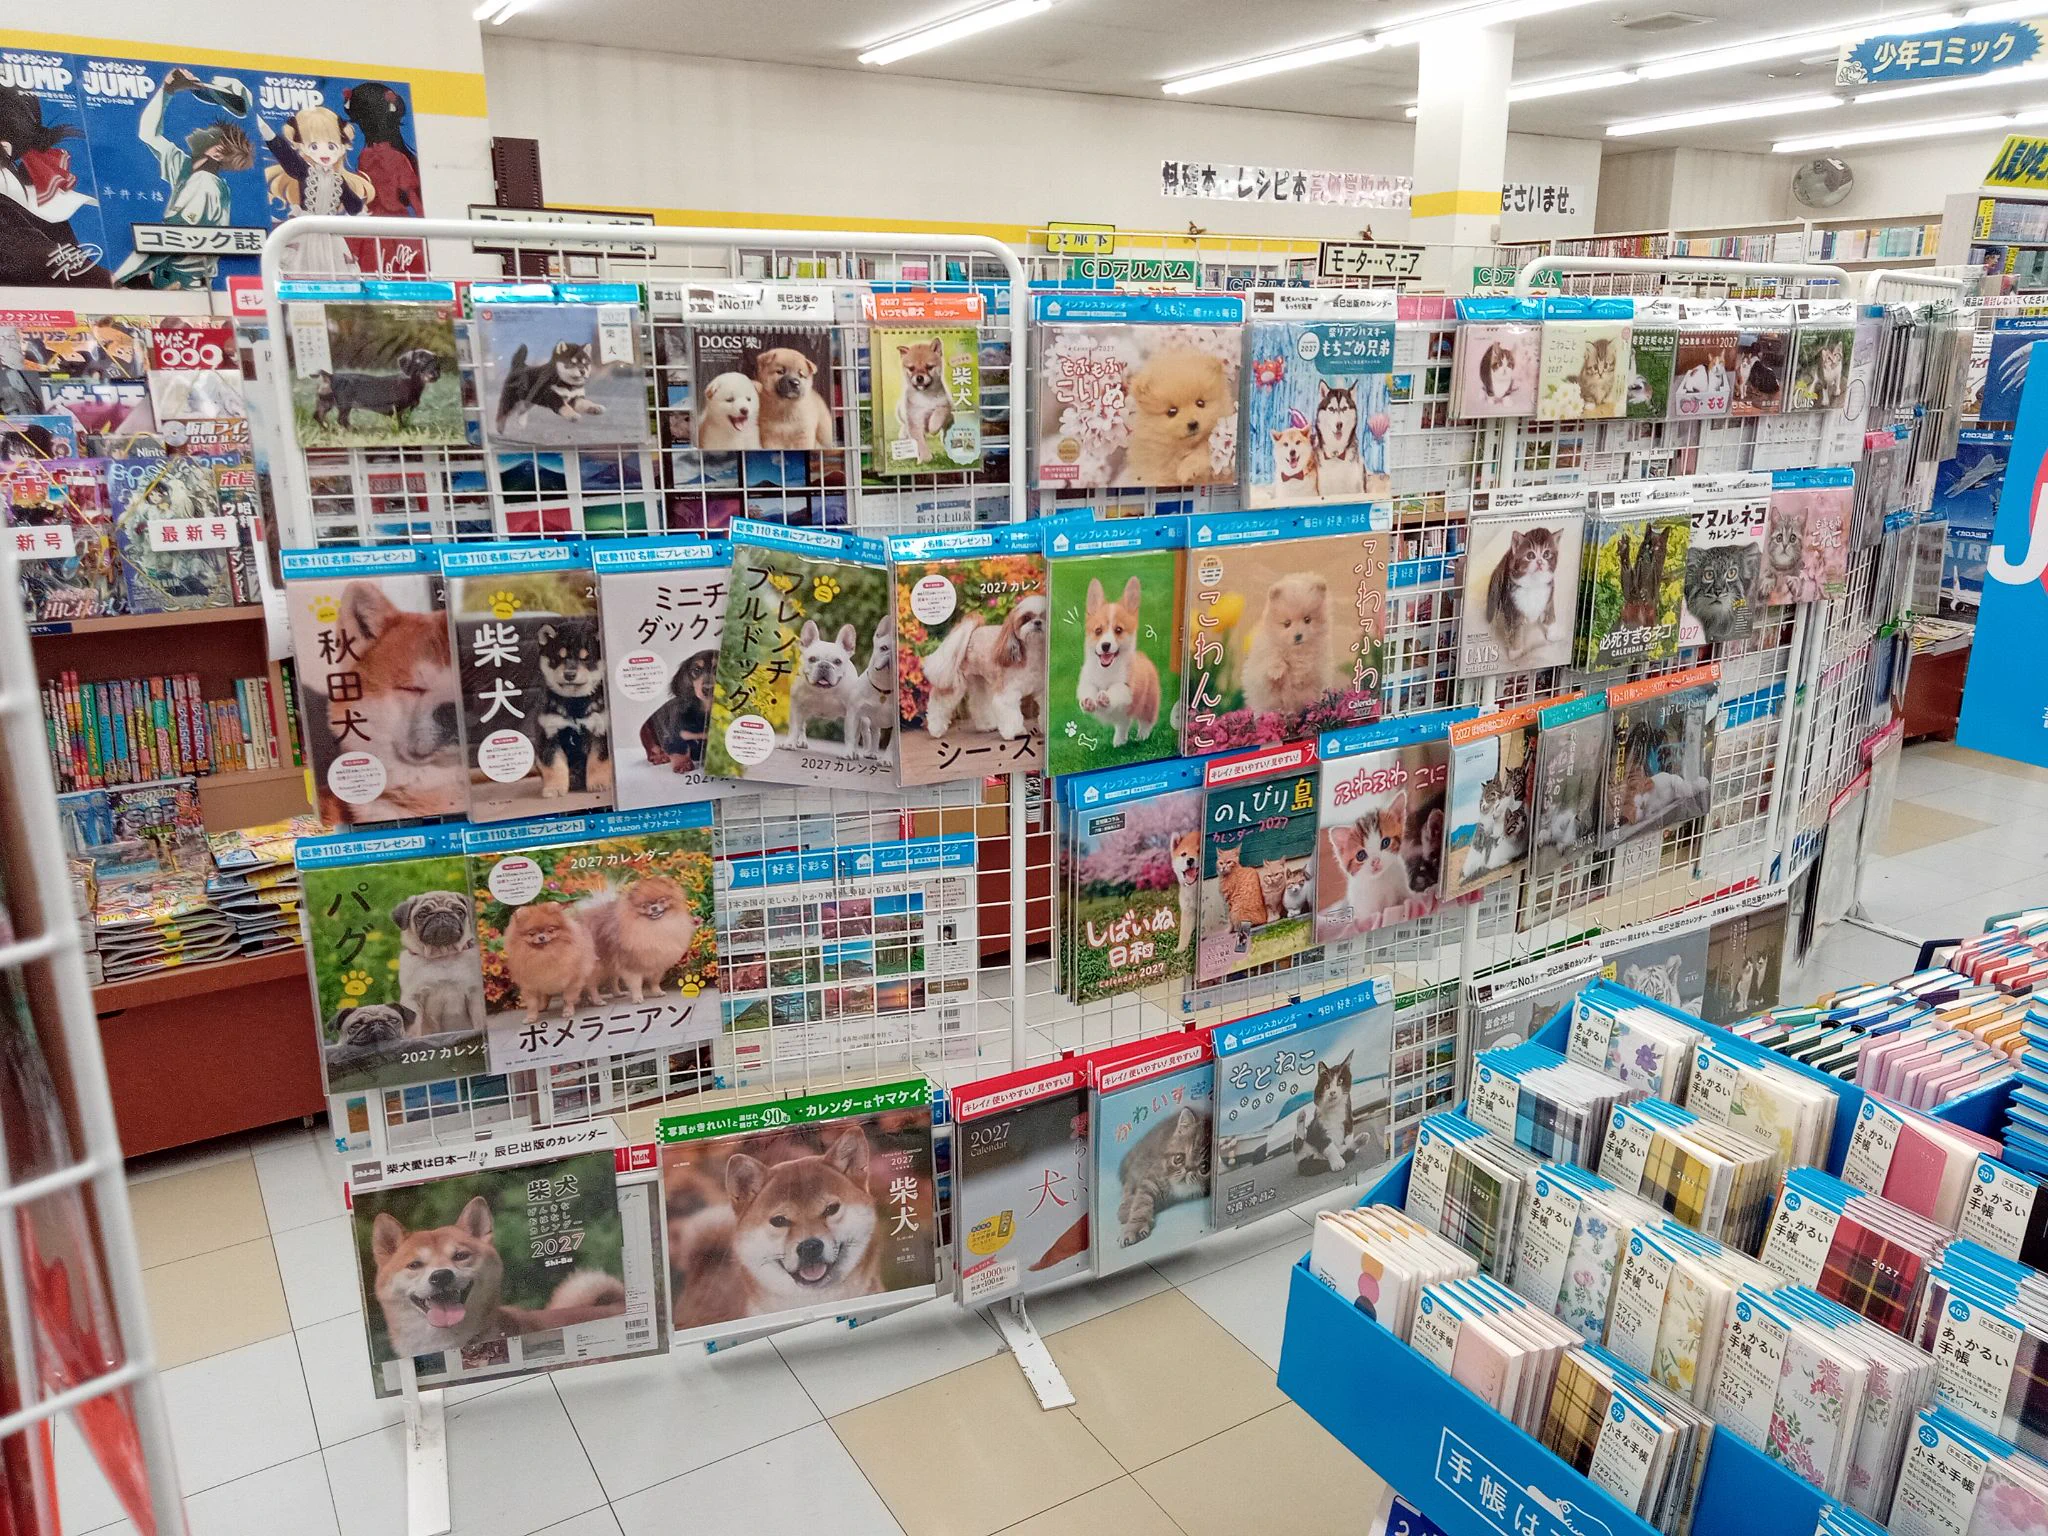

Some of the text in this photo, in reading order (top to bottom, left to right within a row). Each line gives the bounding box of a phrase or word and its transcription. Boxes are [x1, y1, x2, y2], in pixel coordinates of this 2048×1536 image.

[1872, 32, 2015, 73] 少年コミック
[141, 229, 263, 251] コミック誌
[1081, 260, 1190, 280] CDアルバム
[1479, 268, 1557, 284] CDアバム
[780, 303, 816, 311] カレンダー
[154, 331, 204, 349] サイボーグ
[1301, 345, 1317, 353] 2027
[1321, 339, 1391, 358] もちごめ兄弟
[1720, 336, 1738, 348] 2027
[1061, 357, 1121, 378] もふもふ
[952, 367, 973, 407] 柴犬
[1056, 380, 1125, 410] こいぬ
[162, 521, 227, 543] 最新号
[1707, 529, 1745, 541] カレンダー
[656, 581, 728, 611] ミニチ
[980, 581, 1006, 594] 2027
[1350, 539, 1385, 694] ふわふわ
[729, 565, 776, 713] ブルドッグ
[1600, 624, 1672, 651] 必死すぎるネコ
[1466, 643, 1499, 665] CATS
[1611, 646, 1644, 657] CALENDAR
[473, 622, 526, 724] 柴犬
[1191, 591, 1224, 748] こわんこ
[1464, 663, 1500, 674] COLLECTION
[318, 628, 372, 743] 秋田犬
[1348, 698, 1379, 710] Calendar
[801, 757, 891, 775] 2027 カレンダー
[1334, 761, 1408, 808] ふわふわ
[1214, 777, 1314, 824] のんびり島
[608, 824, 641, 833] Amazon
[1212, 815, 1289, 844] カレンダー 2027
[571, 849, 670, 869] 2027 カレンダー
[325, 881, 374, 966] パグ
[1086, 906, 1177, 948] しばいぬ
[1107, 942, 1156, 969] 日和
[1139, 963, 1165, 979] 2027
[519, 1005, 692, 1054] ポメラニアン
[401, 1049, 436, 1065] 2027
[1230, 1049, 1317, 1092] そとねこ
[1692, 1082, 1709, 1099] 手帳
[1694, 1071, 1730, 1096] あ、かるい
[805, 1089, 920, 1118] カレンダーはヤマケイ
[1475, 1095, 1494, 1112] 手帳
[1477, 1085, 1515, 1108] あ、かるい
[494, 1130, 608, 1158] 辰巳出版のカレンダー
[971, 1122, 1010, 1149] 2027
[1608, 1130, 1645, 1157] あ、かるい
[1755, 1125, 1772, 1139] 2027
[1854, 1133, 1871, 1153] 手帳
[1858, 1121, 1892, 1150] あ、かるい
[386, 1151, 478, 1174] 柴犬愛は日本一!!
[891, 1155, 914, 1166] 2027
[1416, 1146, 1447, 1173] あ、かるい
[1605, 1142, 1623, 1160] 手帳
[1414, 1158, 1430, 1176] 手帳
[1676, 1171, 1696, 1187] 2027
[1979, 1169, 1993, 1182] 301
[527, 1174, 579, 1201] 柴犬
[1025, 1169, 1070, 1219] 犬
[1473, 1186, 1490, 1201] 2027
[889, 1176, 919, 1237] 柴犬
[1531, 1197, 1572, 1228] あ、かるい
[1785, 1198, 1799, 1209] 404
[1969, 1196, 1995, 1220] 手帳
[1973, 1184, 2026, 1217] あ、かるい
[1530, 1209, 1549, 1230] 手帳
[1779, 1211, 1828, 1243] あ、かるい
[530, 1232, 586, 1259] 2027
[1774, 1223, 1799, 1246] 手帳
[1623, 1267, 1641, 1290] 手帳
[1626, 1255, 1664, 1290] あ、かるい
[1871, 1258, 1899, 1278] 2027
[1949, 1305, 1968, 1320] 405
[1417, 1315, 1454, 1350] 小さな手帳
[1732, 1321, 1780, 1360] あ、かるい
[1728, 1334, 1752, 1360] 手帳
[1939, 1340, 1971, 1367] 手帳
[1942, 1326, 2009, 1367] あ、かるい
[1720, 1380, 1738, 1398] スリム
[1722, 1371, 1753, 1400] ラフィーネ
[1612, 1407, 1624, 1421] 372
[1606, 1422, 1649, 1464] 小さな手帳
[1919, 1431, 1937, 1445] 257
[1914, 1445, 1976, 1494] 小さな手帳
[1902, 1487, 1935, 1516] ラフィーネ
